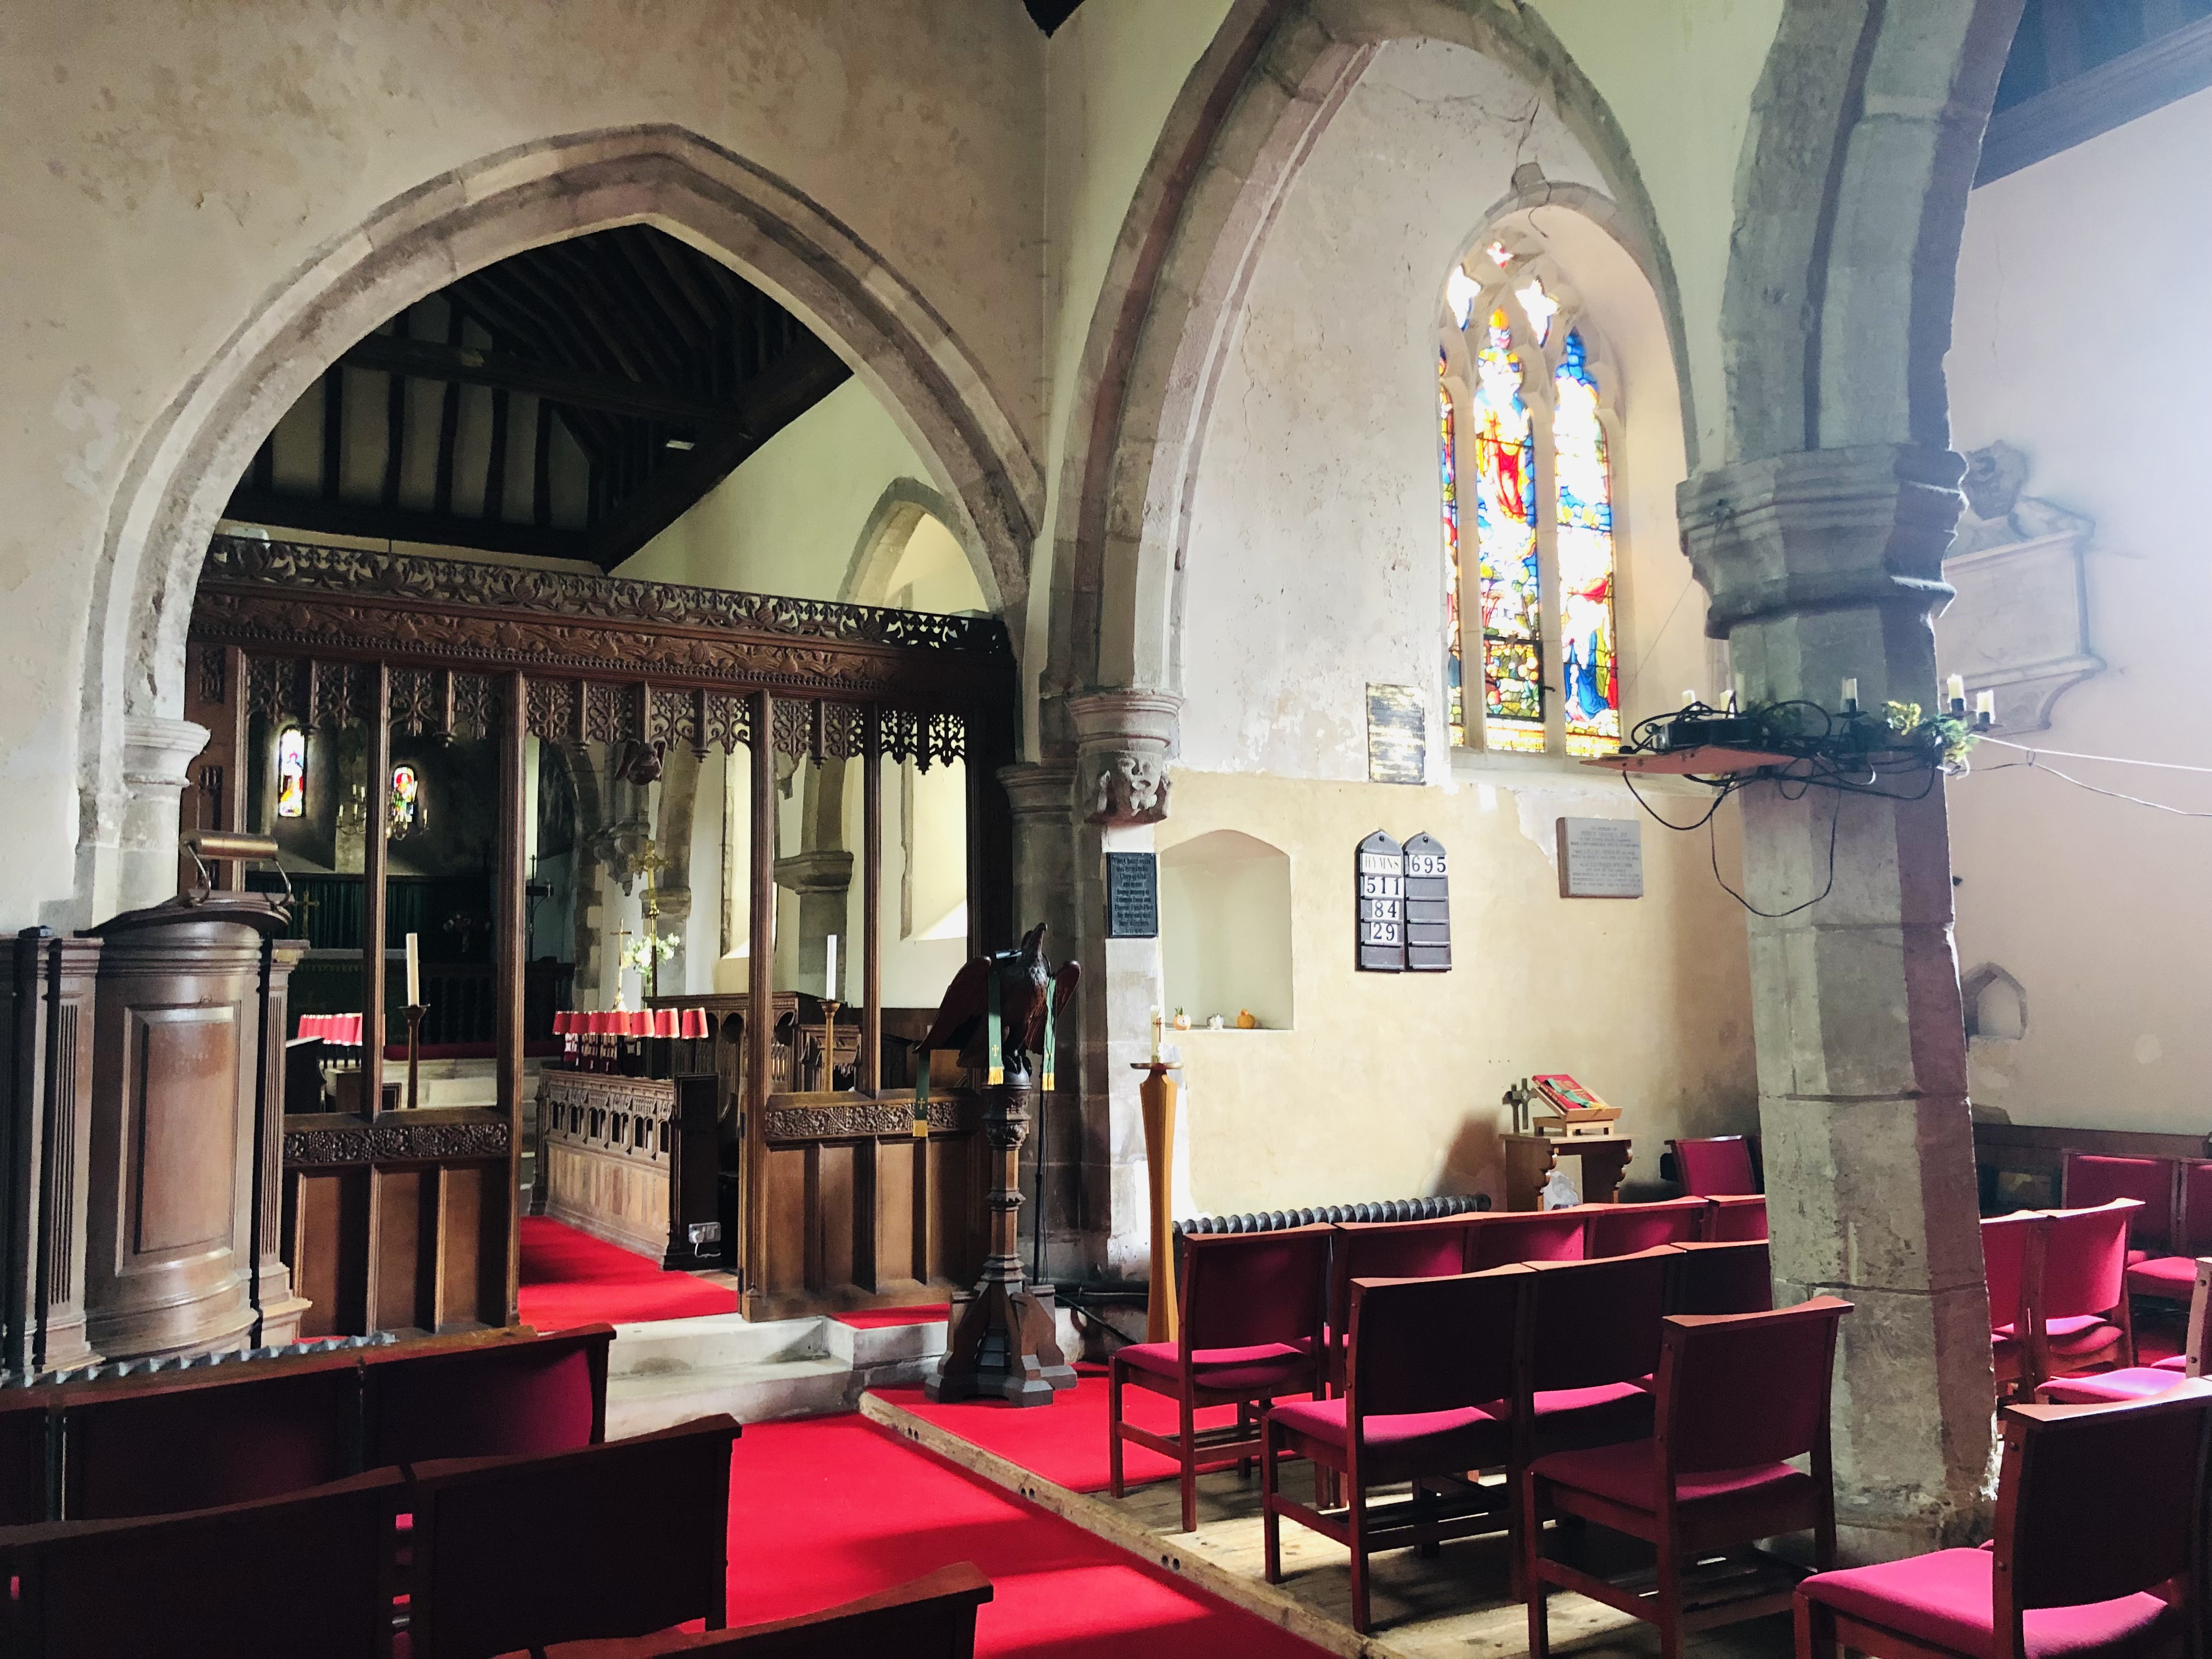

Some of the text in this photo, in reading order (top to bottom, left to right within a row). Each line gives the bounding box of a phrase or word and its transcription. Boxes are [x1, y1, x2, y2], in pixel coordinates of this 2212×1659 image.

[1365, 855, 1399, 870] HYMNS
[1412, 855, 1446, 873] 695
[1367, 877, 1399, 895] 511
[1374, 901, 1397, 918] 84
[1373, 922, 1395, 941] 29
